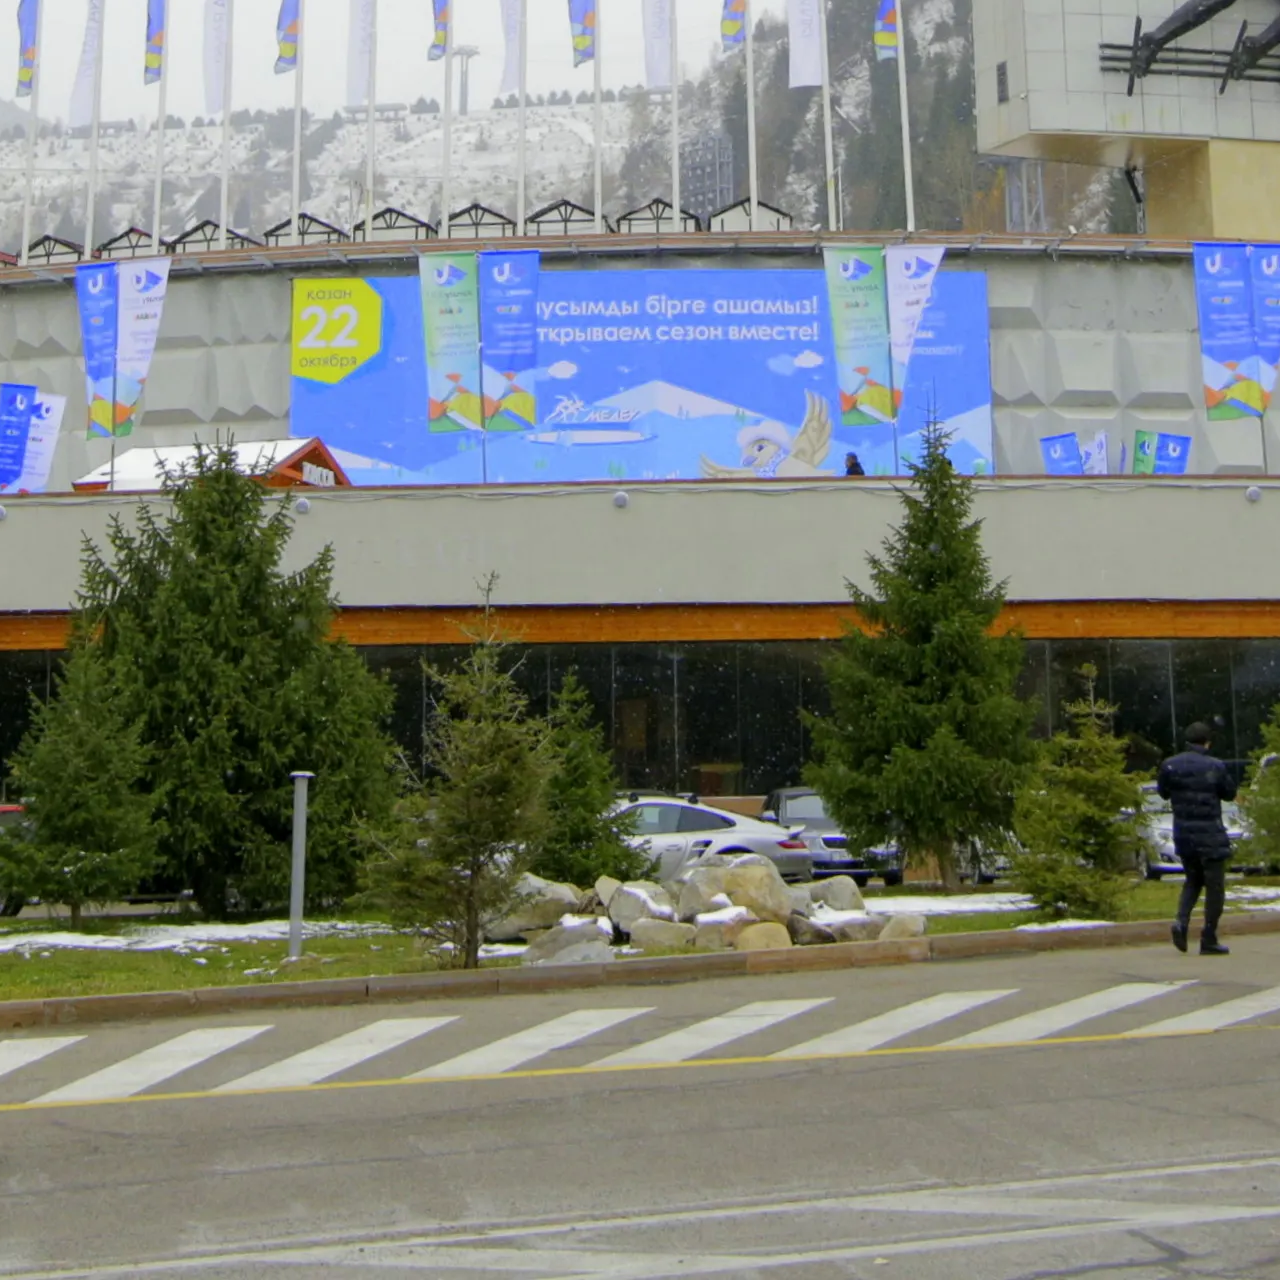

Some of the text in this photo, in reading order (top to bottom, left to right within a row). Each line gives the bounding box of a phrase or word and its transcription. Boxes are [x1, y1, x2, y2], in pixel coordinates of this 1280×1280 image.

[645, 295, 707, 318] бірге
[713, 296, 818, 315] ашамыз!
[298, 304, 359, 348] 22
[536, 325, 652, 345] ткрываем
[656, 325, 723, 342] сезон
[728, 322, 818, 342] вместе!
[298, 353, 358, 369] октября
